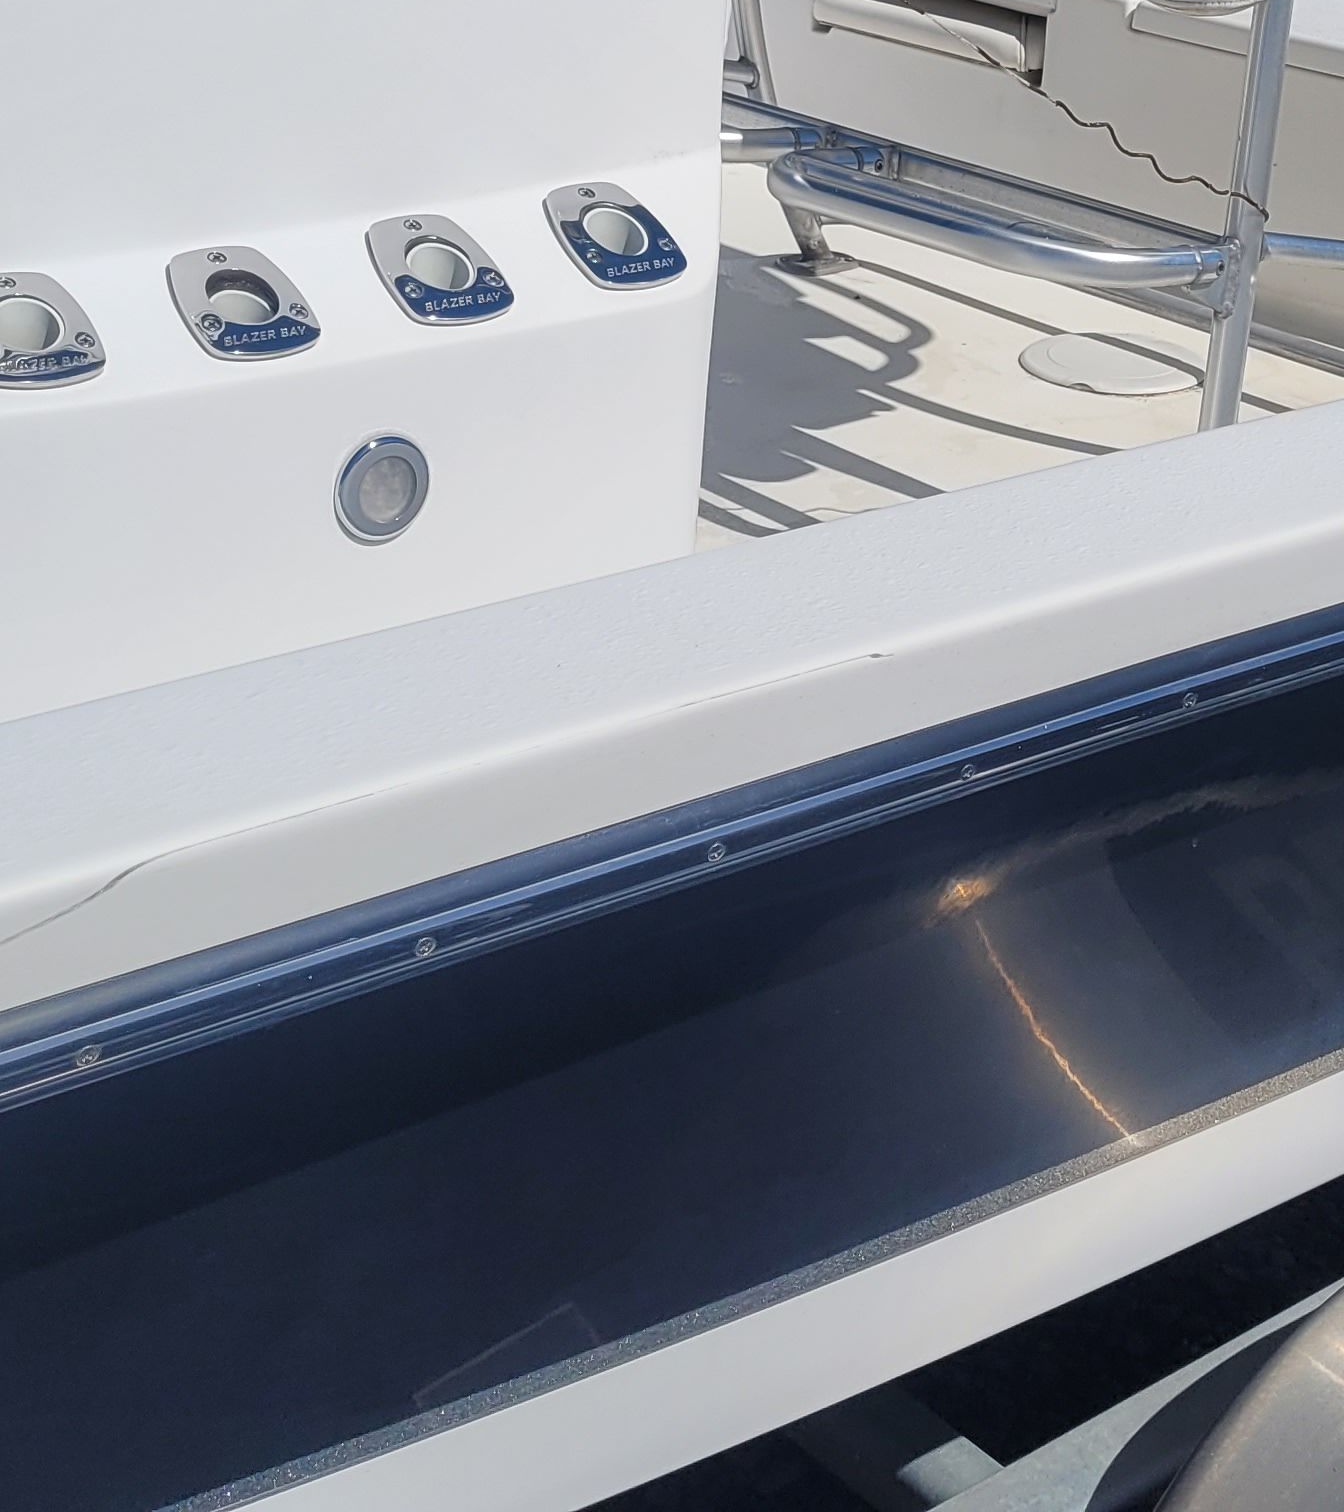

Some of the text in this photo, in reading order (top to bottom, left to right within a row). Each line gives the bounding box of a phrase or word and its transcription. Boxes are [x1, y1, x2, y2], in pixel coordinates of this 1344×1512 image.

[605, 257, 675, 278] BLAZER BAY
[424, 291, 501, 313] BLAZER BAY
[222, 325, 307, 348] BLAZER BAY
